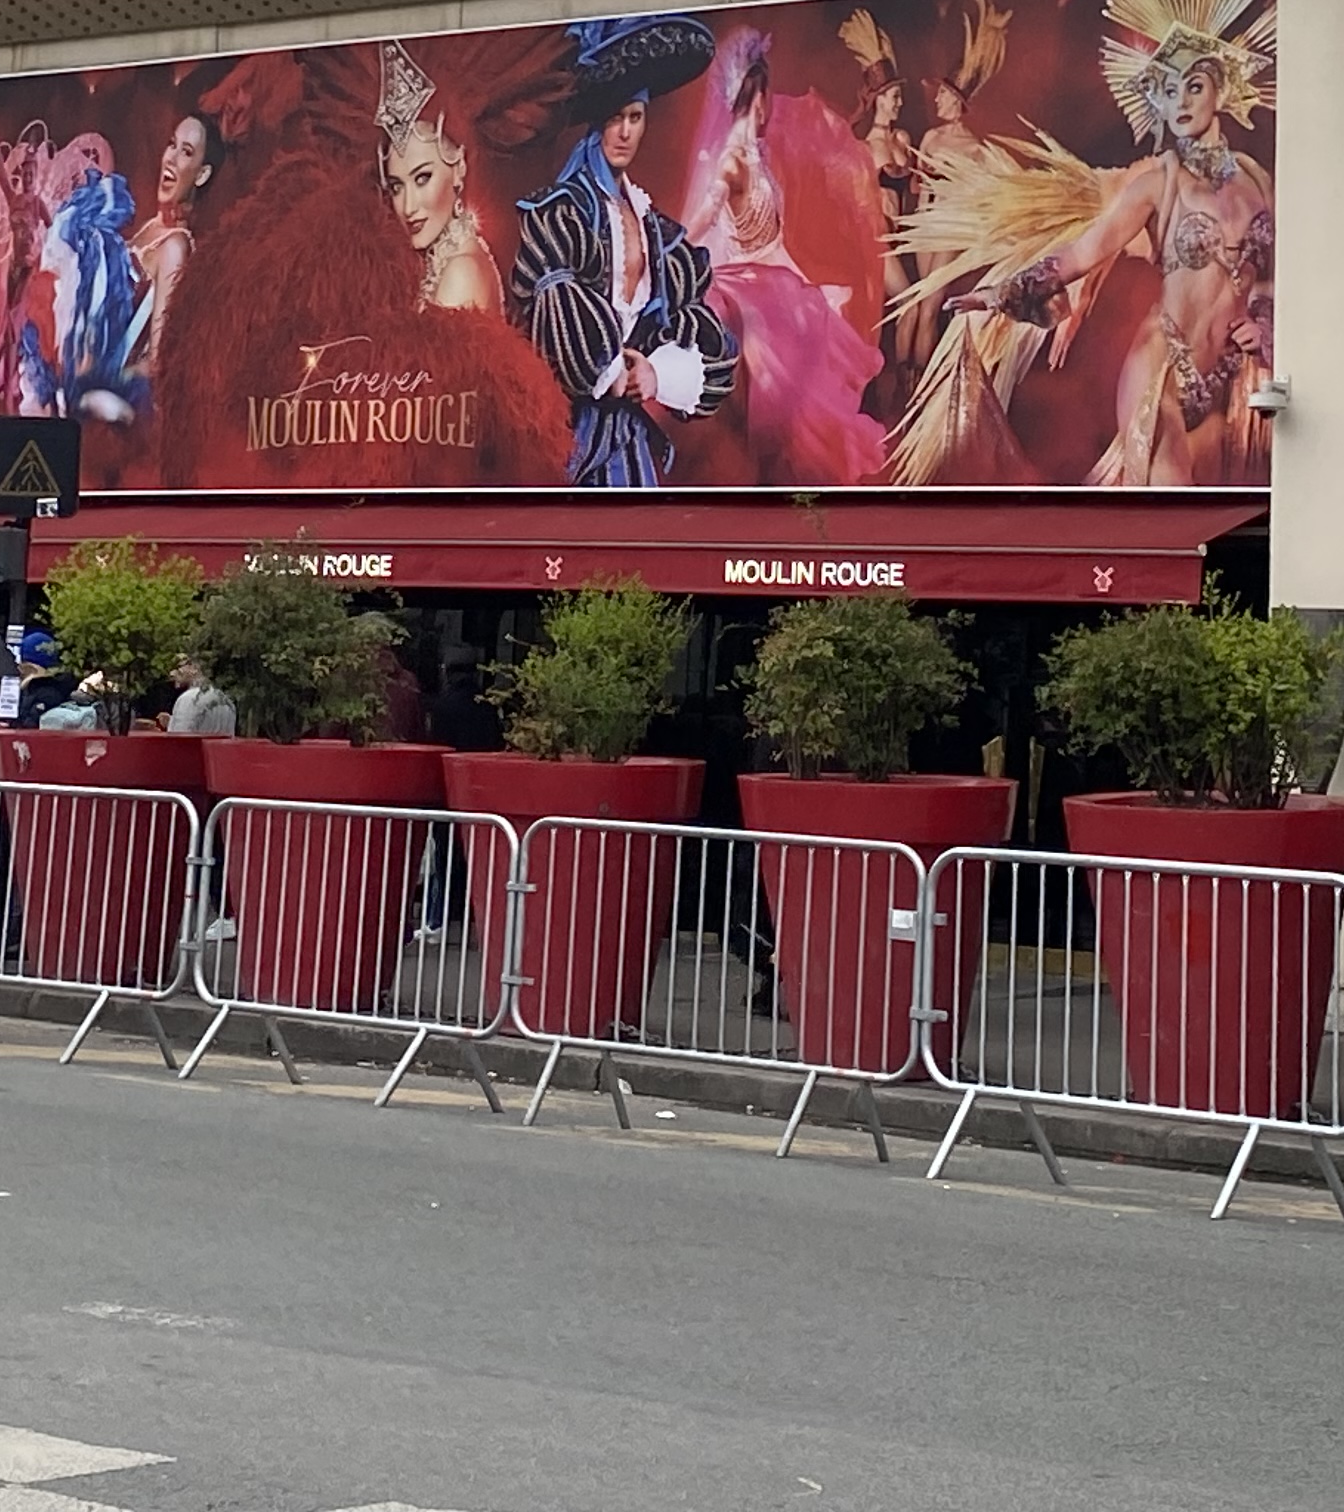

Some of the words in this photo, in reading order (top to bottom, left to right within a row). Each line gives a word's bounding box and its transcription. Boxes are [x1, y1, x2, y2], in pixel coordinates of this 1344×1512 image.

[280, 335, 434, 414] Forever
[246, 396, 360, 452] MOULIN
[366, 391, 478, 448] ROUGE
[322, 554, 394, 577] ROUGE
[724, 559, 815, 586] MOULIN
[821, 561, 905, 587] ROUGE
